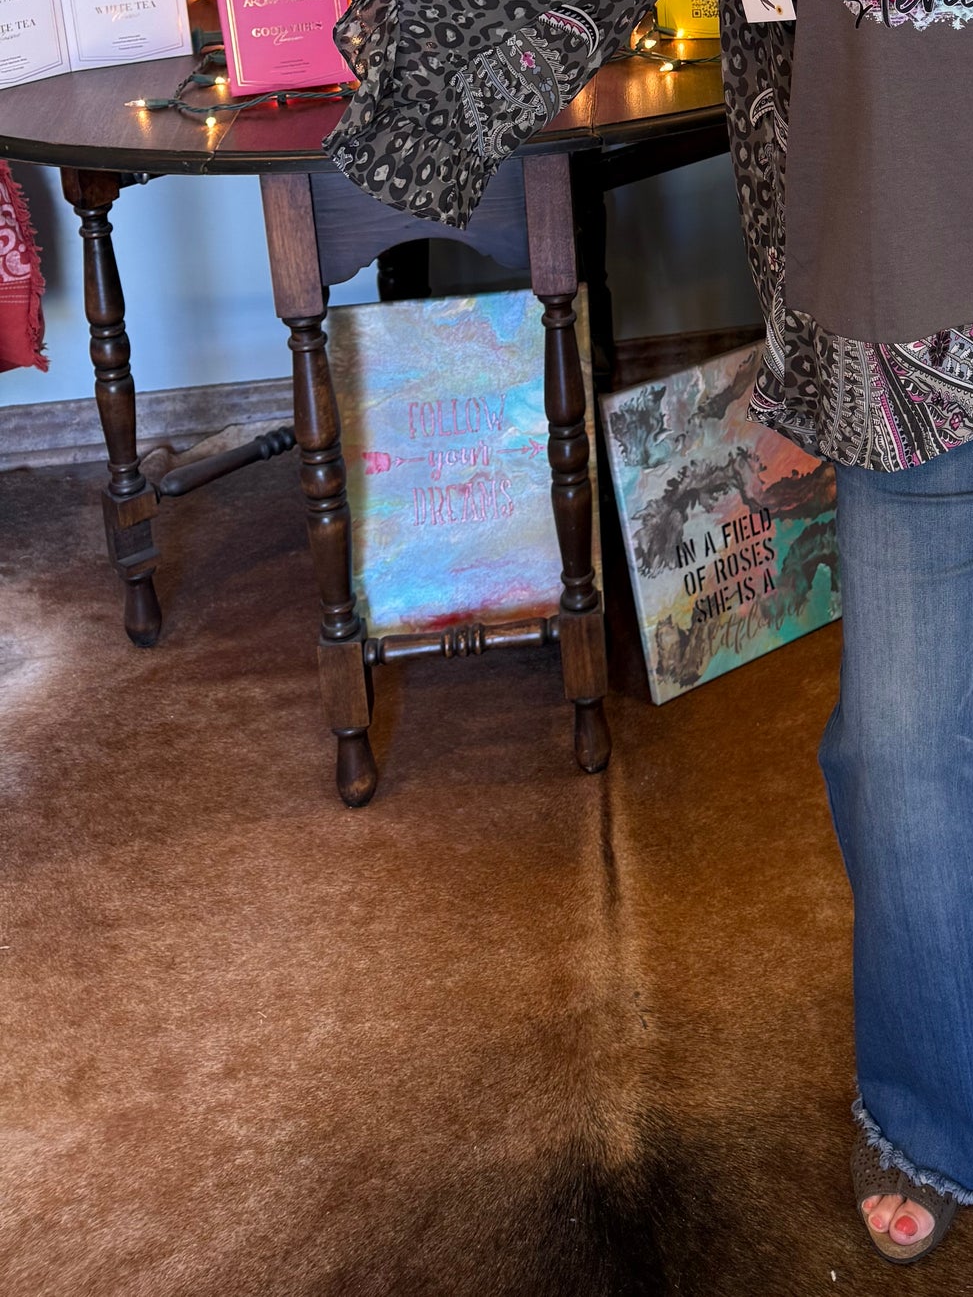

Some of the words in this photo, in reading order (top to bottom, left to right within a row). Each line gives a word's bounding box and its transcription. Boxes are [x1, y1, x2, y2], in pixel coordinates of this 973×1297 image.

[16, 18, 37, 31] TEA
[135, 0, 157, 11] TEA
[408, 393, 506, 439] FOLLOW
[428, 440, 491, 481] your
[412, 479, 514, 526] DREAMS
[676, 538, 697, 569] IN
[704, 531, 717, 558] A
[721, 507, 772, 549] FIELD
[683, 565, 706, 596] OF
[714, 537, 775, 584] ROSES
[695, 586, 732, 623] SHE
[737, 577, 756, 605] IS
[763, 568, 775, 594] A
